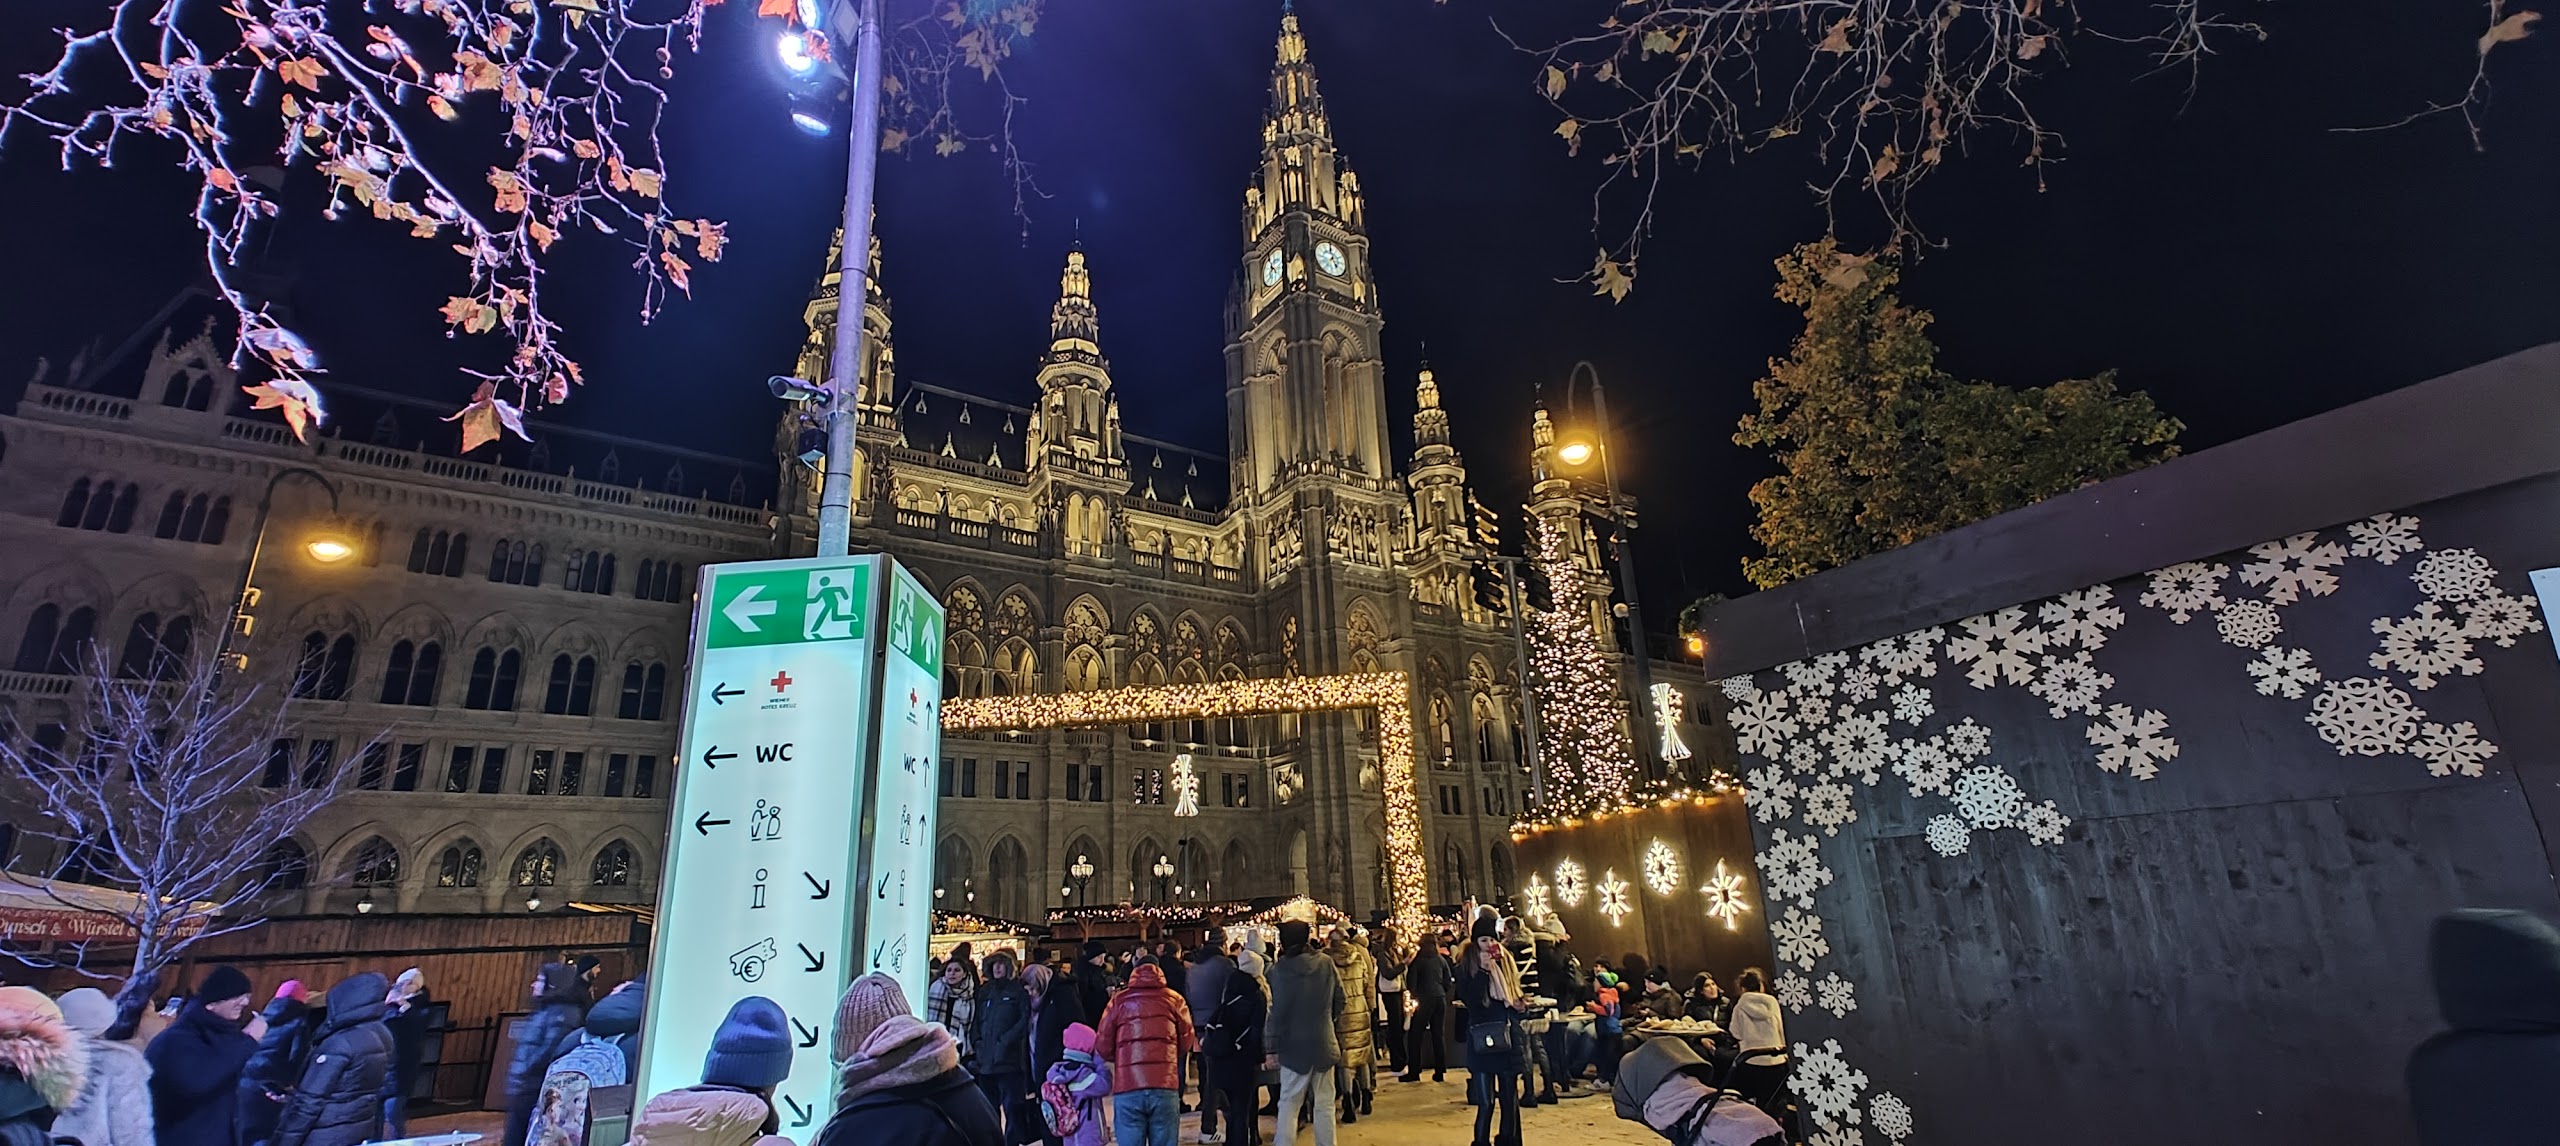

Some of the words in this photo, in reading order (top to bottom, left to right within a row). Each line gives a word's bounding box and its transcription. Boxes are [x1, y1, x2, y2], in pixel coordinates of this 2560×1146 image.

[756, 743, 793, 763] WC
[904, 753, 916, 775] WC
[50, 923, 61, 936] &
[68, 918, 124, 937] Würstel
